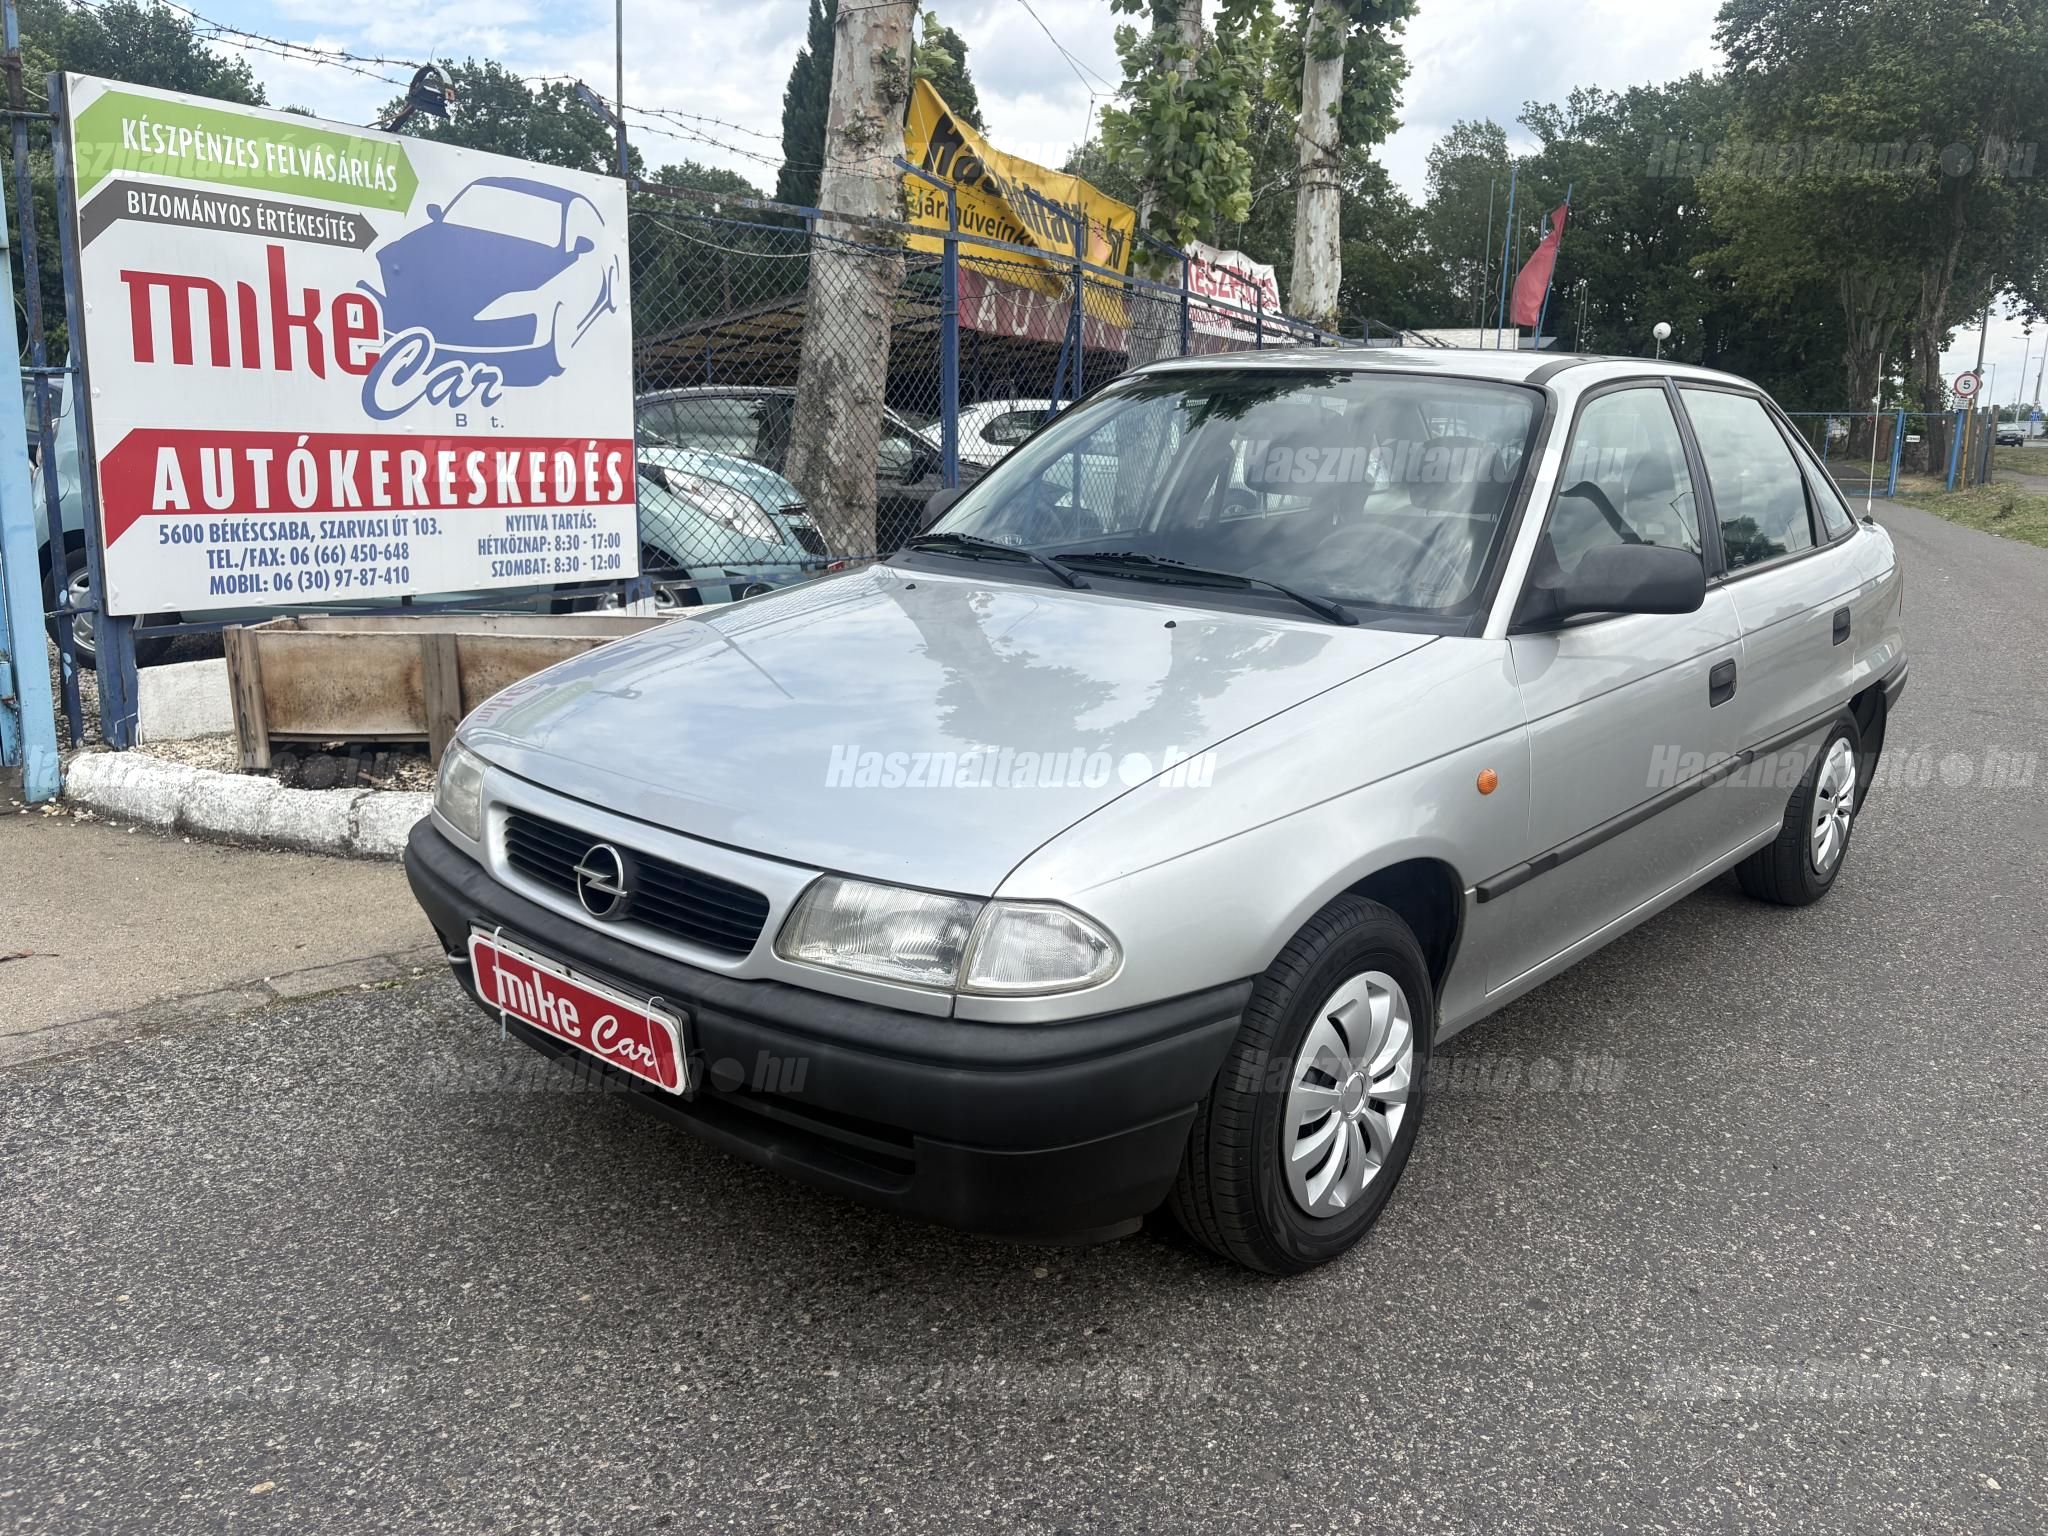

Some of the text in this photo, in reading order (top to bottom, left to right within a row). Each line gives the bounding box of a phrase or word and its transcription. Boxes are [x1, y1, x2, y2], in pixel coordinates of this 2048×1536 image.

[122, 114, 397, 192] KÉSZPÉNZES FELVÁSÁRLÁS
[127, 190, 356, 243] BIZOMÁNYOS ÉRTÉKESÍTÉS
[120, 244, 503, 421] mike Car
[1963, 380, 1971, 390] 5
[151, 434, 625, 511] AUTÓKERESKEDÉS
[159, 515, 443, 545] 5600 BÉKÉSCSABA, SZARVASI ÚT 103.
[506, 509, 597, 533] NYITVA TARTÁS:
[207, 542, 410, 571] TEL./FAX: 06 (66) 450-648
[478, 534, 551, 556] HÉTKÖZNAP:
[554, 535, 580, 552] 8:30
[591, 532, 621, 549] 17:00
[491, 557, 551, 578] SZOMBAT:
[554, 556, 580, 573] 8:30
[590, 553, 621, 571] 12:00
[210, 566, 410, 595] MOBIL: 06 (30) 97-87-410
[492, 965, 656, 1068] mike Car
